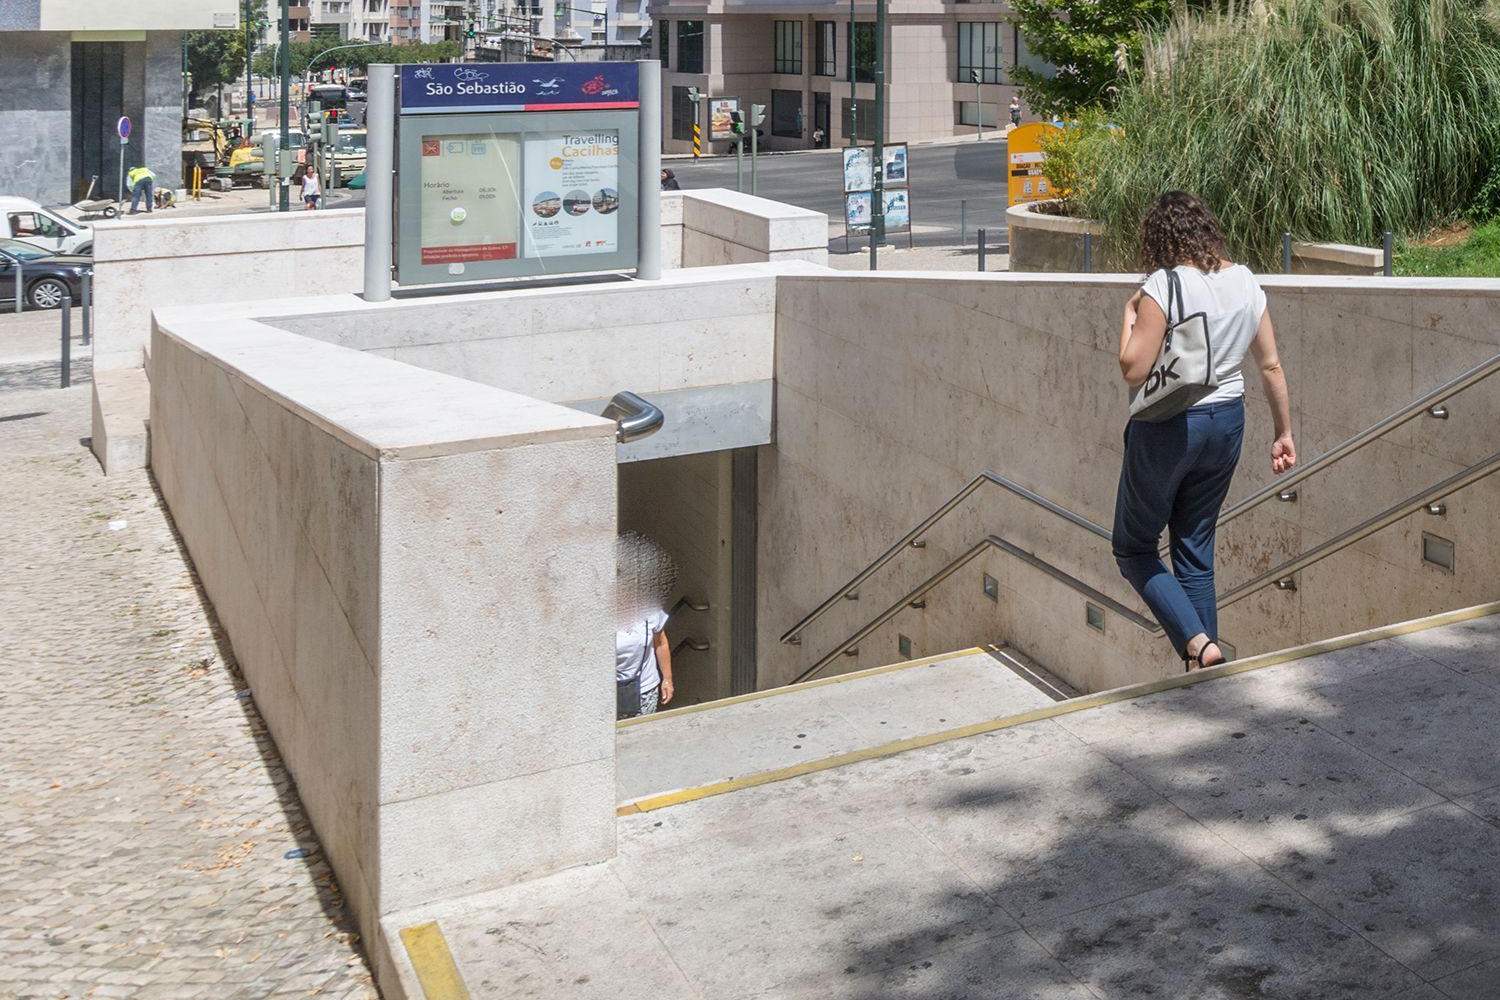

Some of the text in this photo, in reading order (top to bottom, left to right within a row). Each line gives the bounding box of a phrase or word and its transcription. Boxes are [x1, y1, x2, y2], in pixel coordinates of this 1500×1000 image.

[426, 81, 526, 96] São Sebastião
[563, 134, 619, 146] Travelling
[562, 145, 619, 157] Cacilhas
